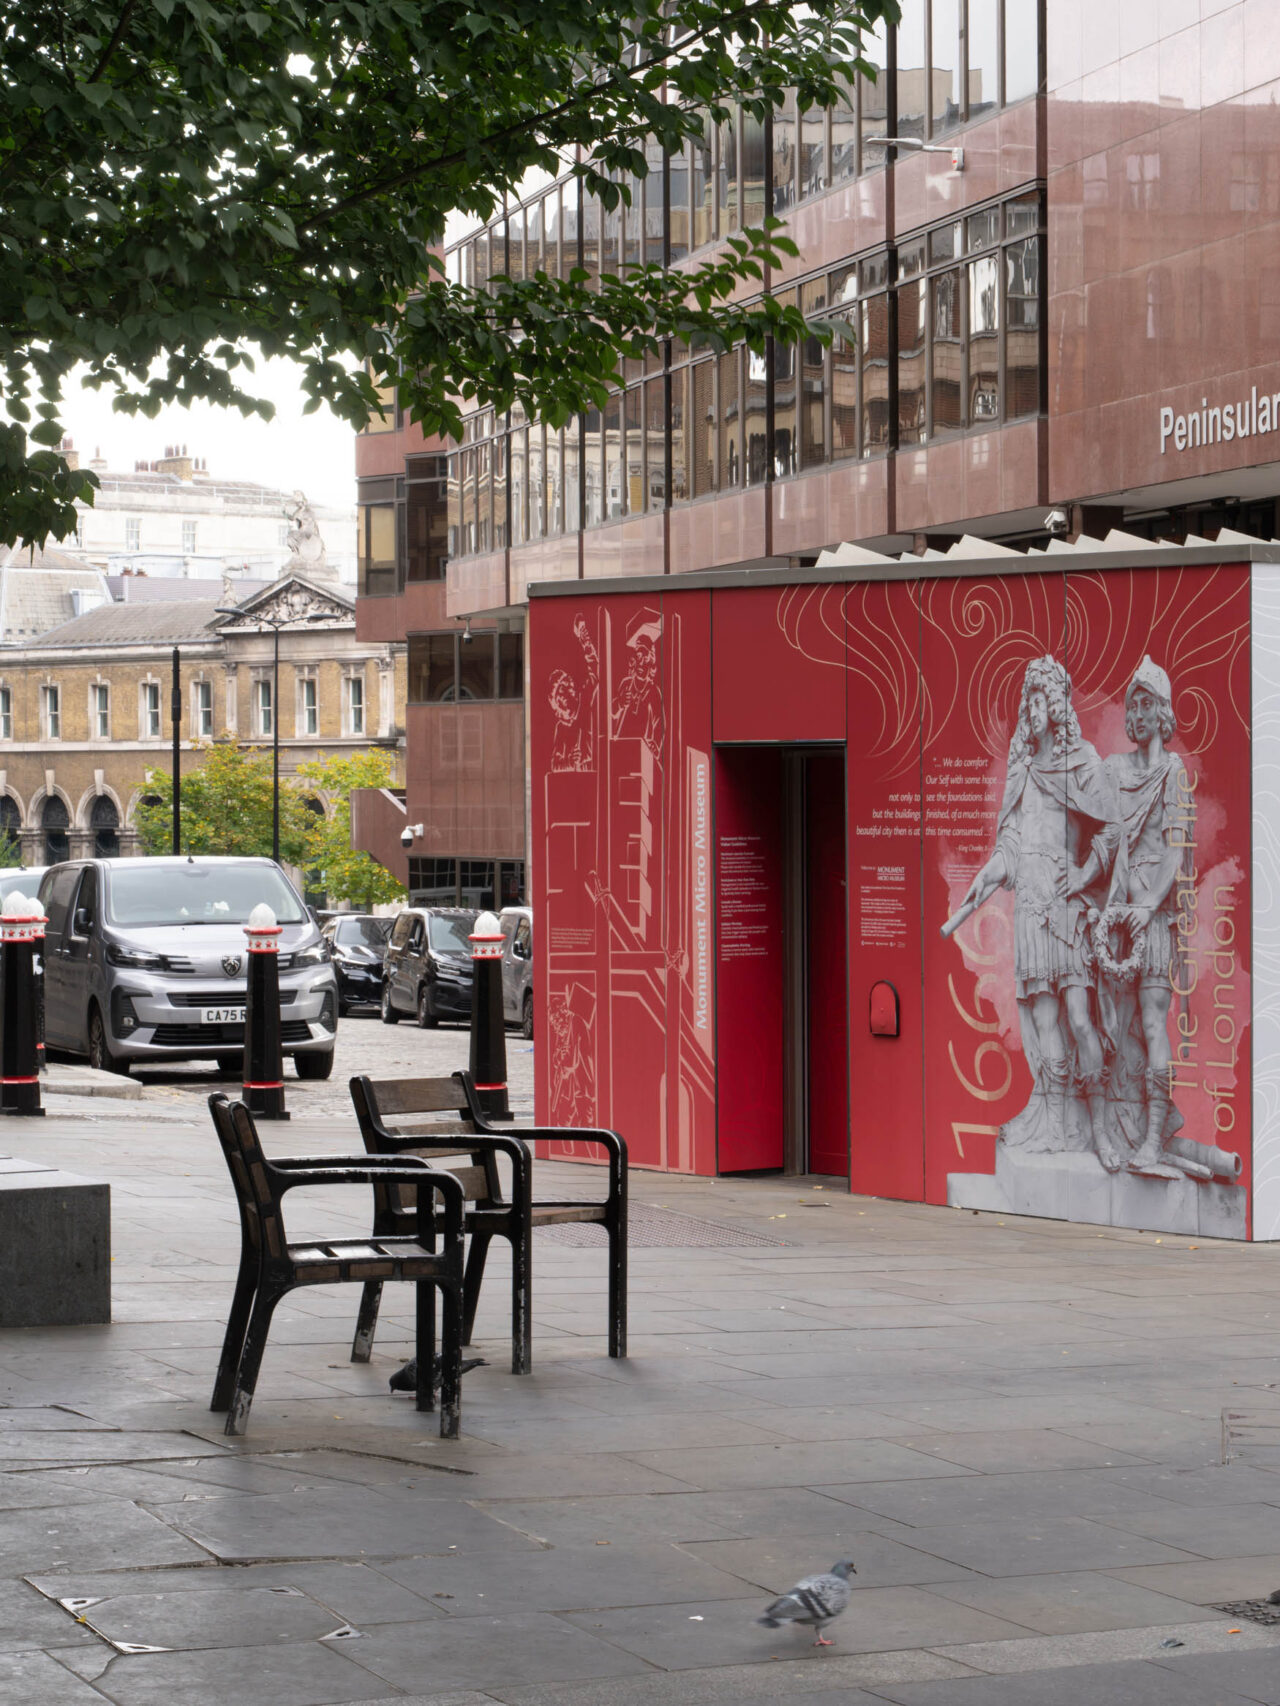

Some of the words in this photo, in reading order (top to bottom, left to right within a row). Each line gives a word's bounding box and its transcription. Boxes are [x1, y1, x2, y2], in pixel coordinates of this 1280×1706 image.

[926, 775, 937, 785] Our
[938, 775, 950, 787] Self
[950, 775, 963, 785] with
[964, 777, 980, 785] some
[982, 775, 997, 786] hope
[943, 758, 953, 767] We
[954, 758, 962, 767] do
[963, 758, 988, 770] comfort
[695, 764, 705, 849] Museum
[872, 809, 883, 818] but
[884, 809, 894, 818] the
[895, 809, 921, 821] buildings
[963, 809, 980, 819] much
[980, 811, 997, 819] more
[889, 793, 899, 801] not
[900, 792, 913, 804] only
[914, 793, 921, 801] to
[937, 792, 947, 801] the
[947, 792, 982, 804] foundations
[1169, 768, 1198, 847] Fire
[856, 825, 881, 838] beautiful
[882, 826, 892, 838] city
[894, 826, 906, 836] then
[907, 827, 912, 836] is
[914, 828, 921, 836] at
[925, 826, 937, 836] this
[937, 826, 951, 836] time
[952, 826, 983, 836] consumed
[695, 855, 706, 913] Micro
[1169, 867, 1199, 996] Great
[697, 920, 707, 1029] Monument
[1204, 886, 1235, 1069] London
[206, 1009, 237, 1021] CA75
[948, 899, 1012, 1159] 1666
[1167, 1012, 1198, 1099] The
[1203, 1079, 1235, 1132] of
